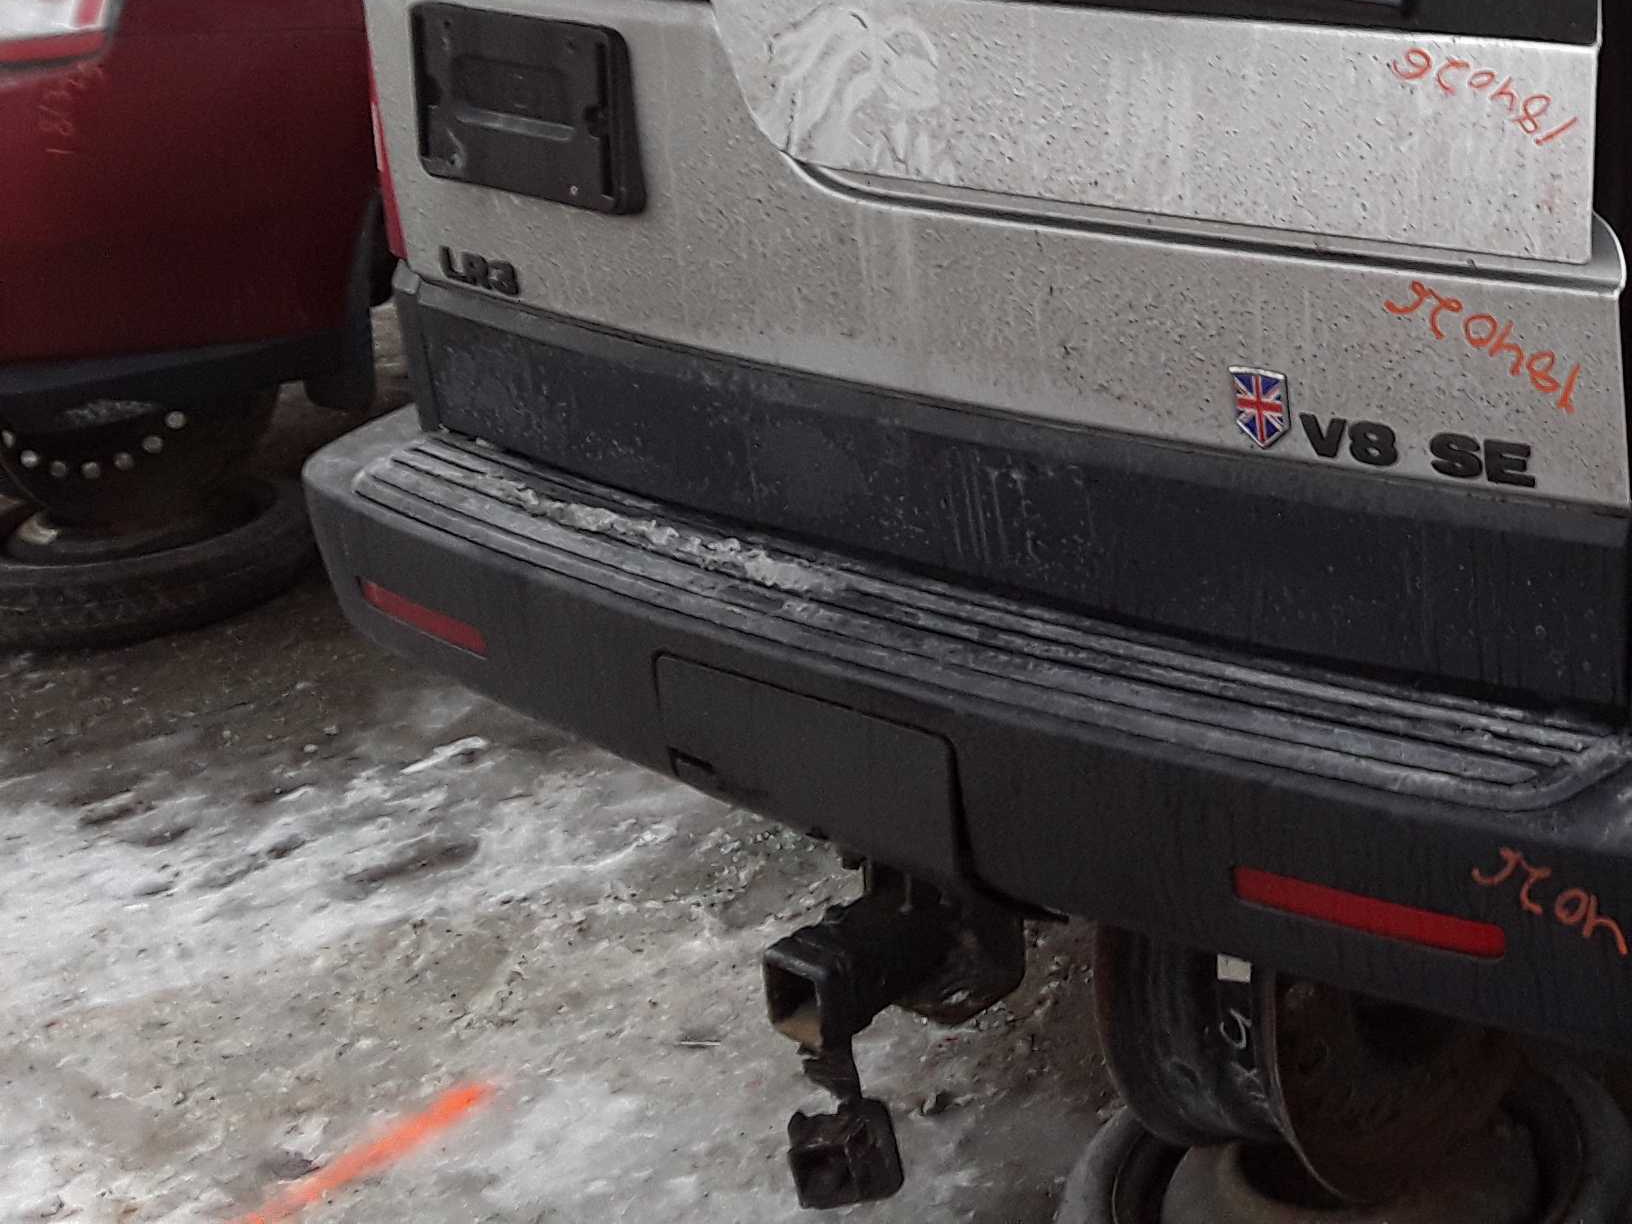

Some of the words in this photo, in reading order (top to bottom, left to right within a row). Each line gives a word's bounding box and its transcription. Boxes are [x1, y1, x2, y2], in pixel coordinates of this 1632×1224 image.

[1393, 48, 1579, 146] 184026
[438, 244, 521, 297] LR3
[1384, 280, 1581, 414] 184026
[1299, 412, 1399, 467] V8
[1429, 432, 1537, 489] SE
